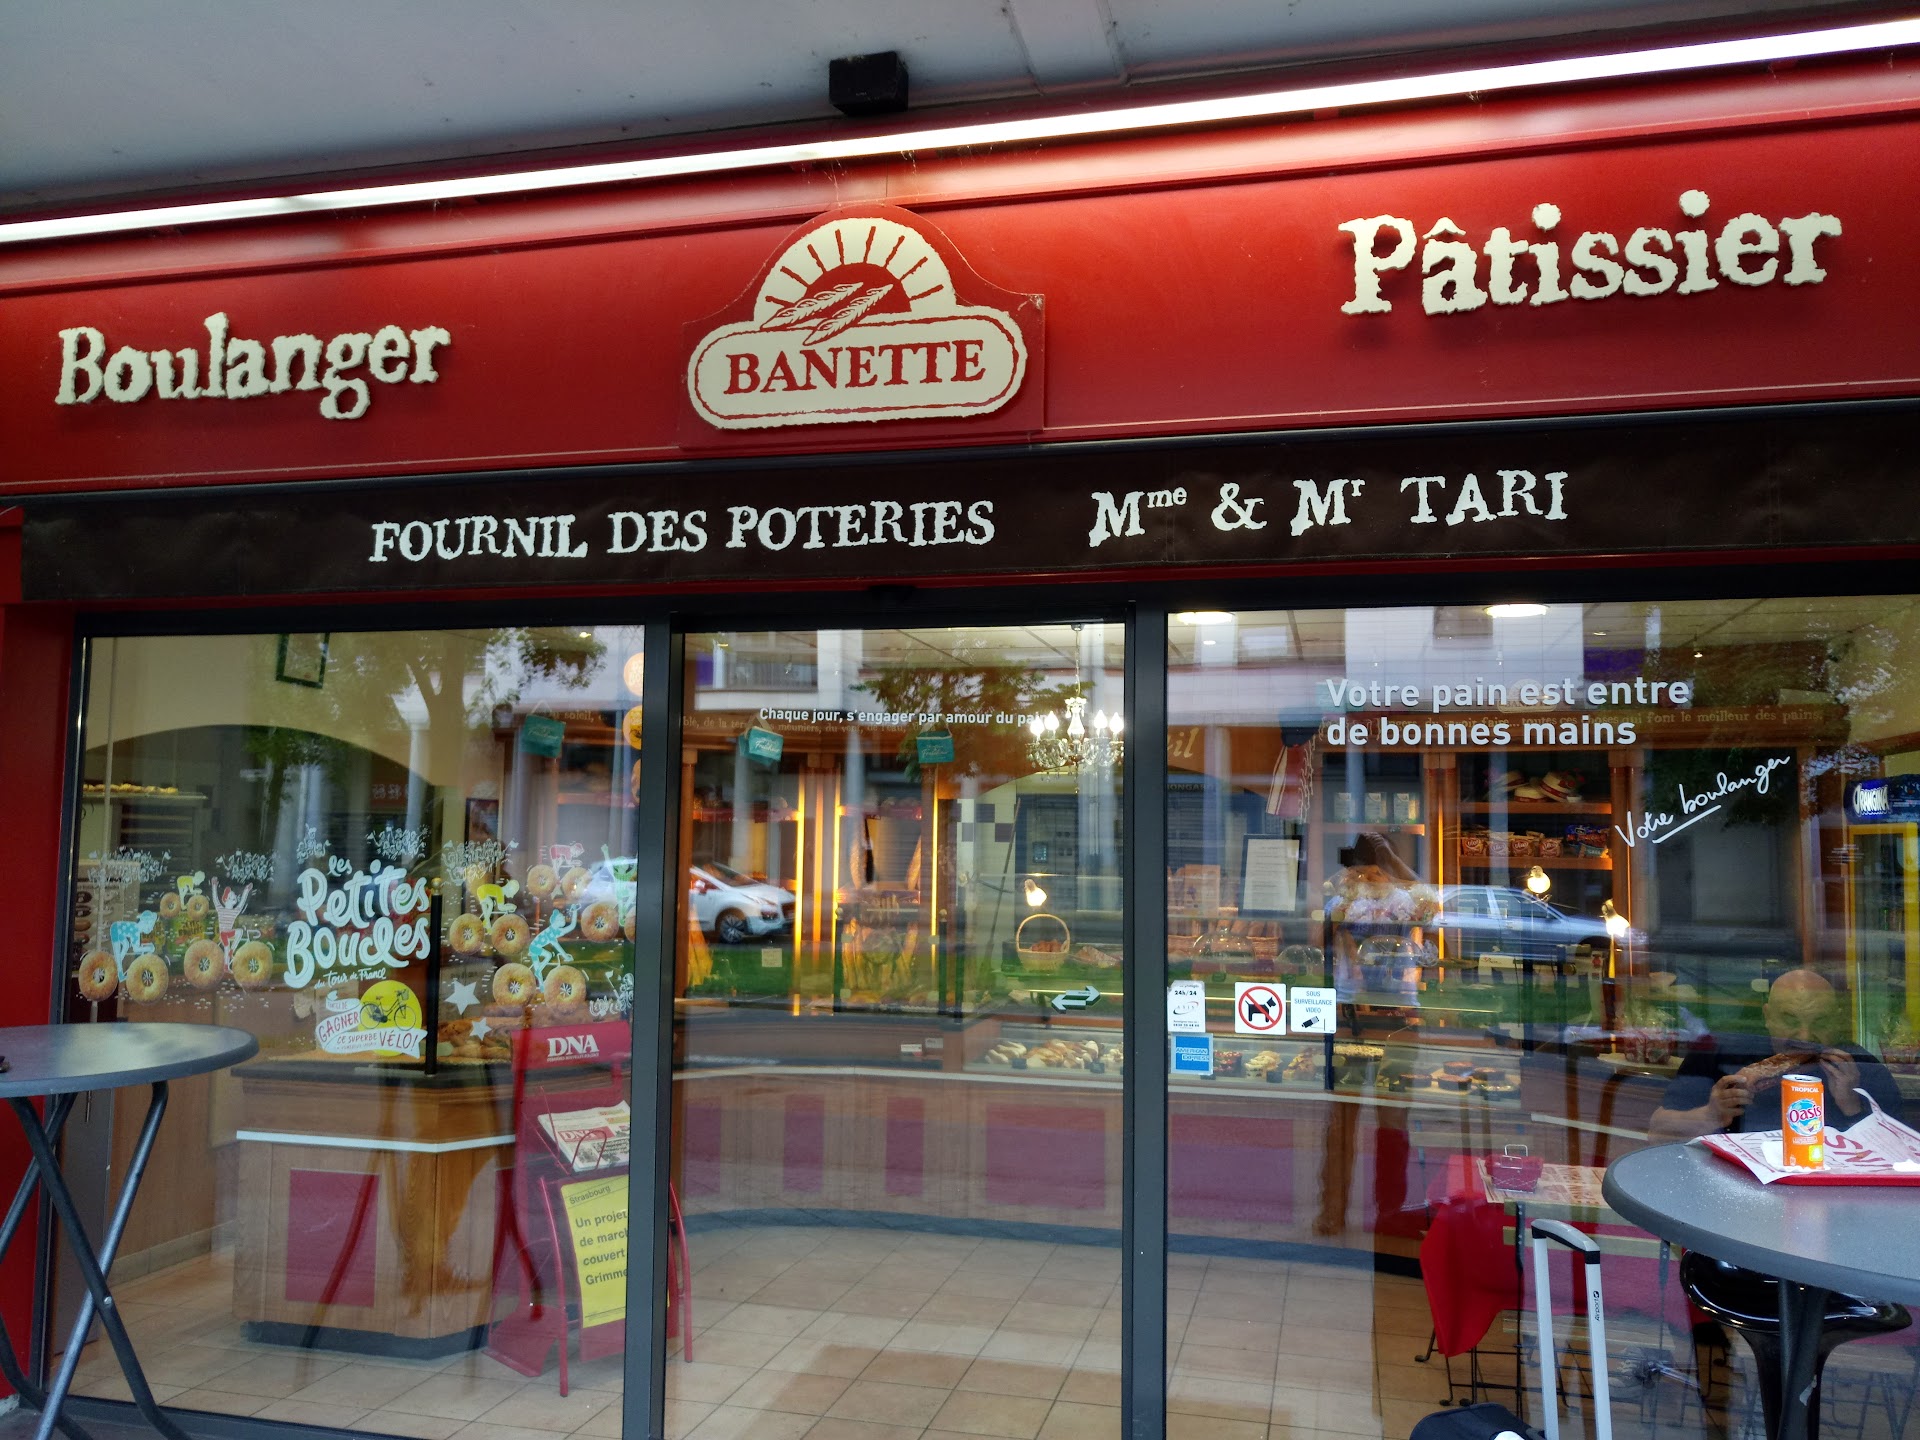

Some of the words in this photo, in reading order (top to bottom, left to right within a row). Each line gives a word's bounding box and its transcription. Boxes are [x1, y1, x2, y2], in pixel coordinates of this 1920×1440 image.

[1338, 189, 1842, 316] Pâtissier
[54, 312, 451, 420] Boulanger
[723, 339, 987, 395] BANETTE
[368, 513, 589, 563] FOURNIL
[606, 509, 708, 555] DES
[724, 500, 996, 550] POTERIES
[1088, 485, 1188, 548] Mme
[1210, 482, 1268, 532] &
[1290, 478, 1366, 536] Mr
[1400, 469, 1569, 527] TARI
[1326, 678, 1420, 707] Votre
[1432, 677, 1507, 713] pain
[1519, 677, 1576, 706] est
[1587, 676, 1690, 705] entre
[759, 707, 809, 723] Chaque
[812, 708, 844, 724] jour,
[846, 709, 915, 726] s'engager
[918, 712, 942, 727] par
[945, 711, 993, 724] amour
[995, 711, 1014, 724] du
[1647, 711, 1676, 723] font
[1681, 710, 1693, 722] le
[1697, 709, 1749, 722] meilleur
[1755, 708, 1777, 721] des
[1326, 717, 1369, 746] de
[1380, 717, 1512, 746] bonnes
[1523, 714, 1637, 745] mains
[1615, 811, 1674, 847] Votre
[1678, 756, 1790, 815] boulanger
[327, 855, 353, 877] les
[297, 859, 430, 929] Petites
[358, 967, 387, 981] France
[1294, 998, 1333, 1006] SURVEILLANCE
[318, 1011, 360, 1043] GAGNER
[348, 1032, 378, 1043] SUPERBE
[379, 1029, 419, 1051] VÉLO!
[547, 1034, 599, 1058] DNA
[1791, 1085, 1820, 1093] TROPICAL
[1789, 1104, 1822, 1123] Oasis
[569, 1184, 612, 1206] Strasbourg
[575, 1217, 592, 1229] Un
[594, 1210, 628, 1227] projet
[580, 1236, 594, 1248] de
[583, 1248, 626, 1267] couvert
